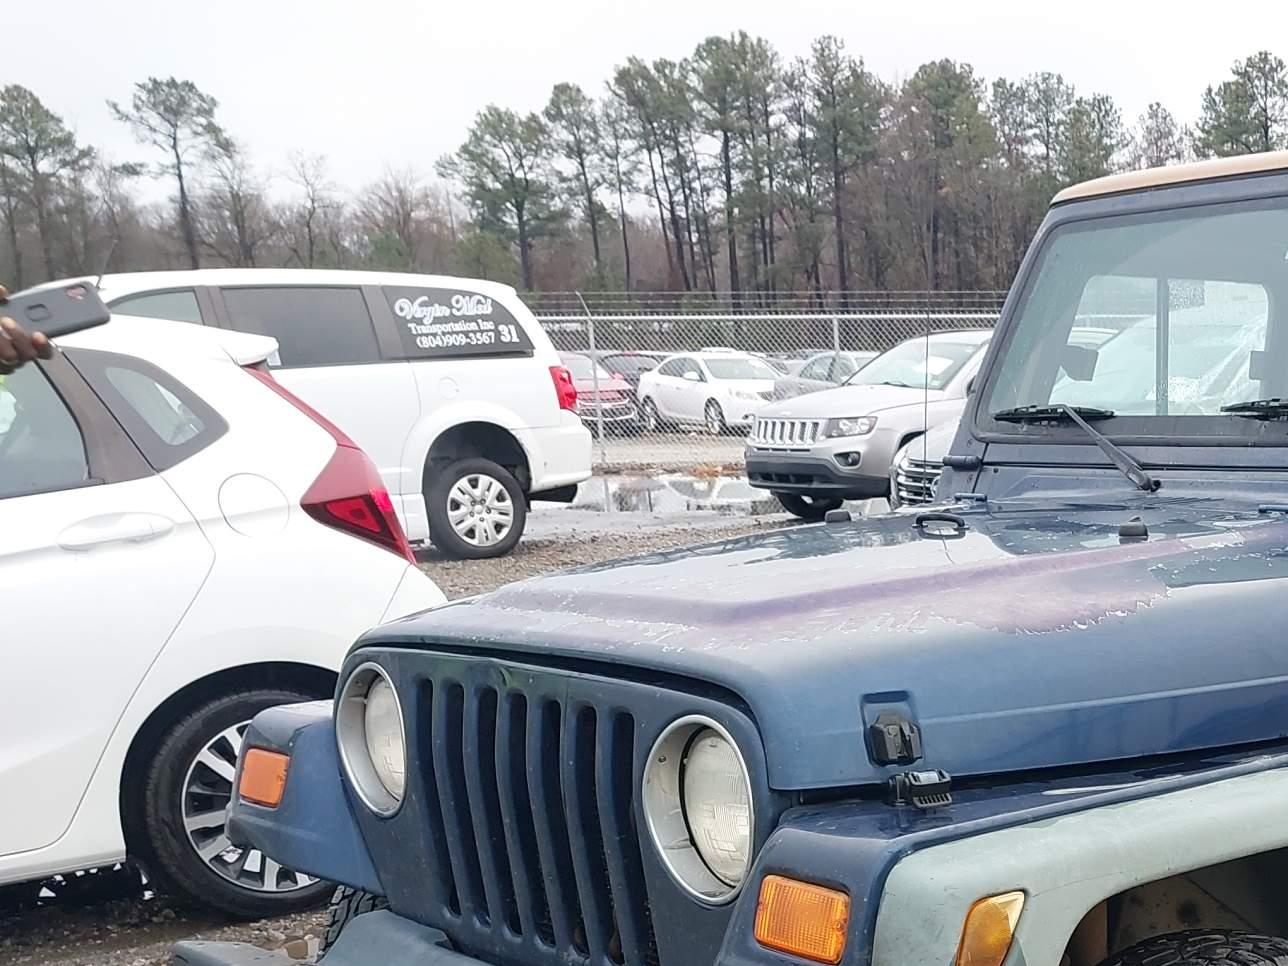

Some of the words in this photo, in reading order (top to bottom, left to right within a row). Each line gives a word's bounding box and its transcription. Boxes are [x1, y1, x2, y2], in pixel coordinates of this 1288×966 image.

[407, 321, 477, 335] Transportation
[478, 319, 495, 330] Inc
[497, 324, 520, 342] 31
[416, 332, 495, 348] (804)909-3567
